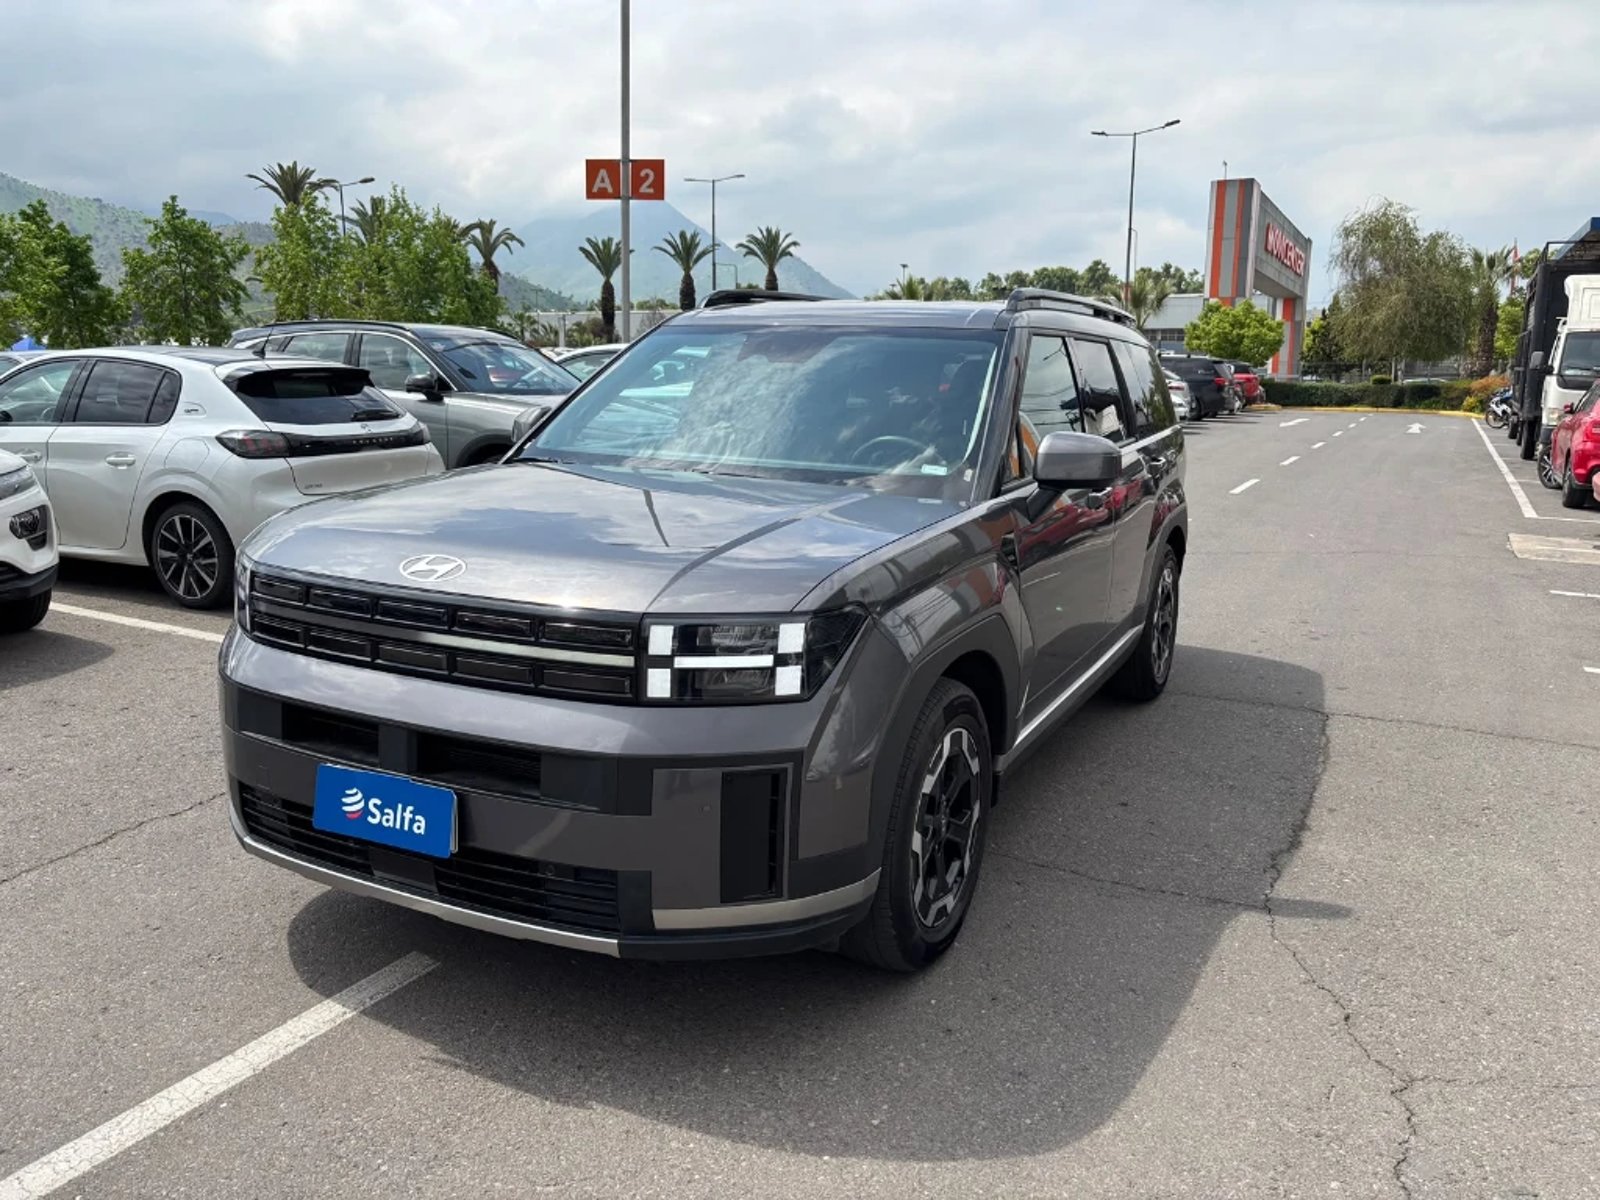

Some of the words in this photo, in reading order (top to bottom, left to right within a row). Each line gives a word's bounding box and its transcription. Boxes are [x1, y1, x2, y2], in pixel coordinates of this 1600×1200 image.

[592, 168, 613, 193] A
[639, 168, 655, 193] 2
[367, 797, 426, 835] Salfa
